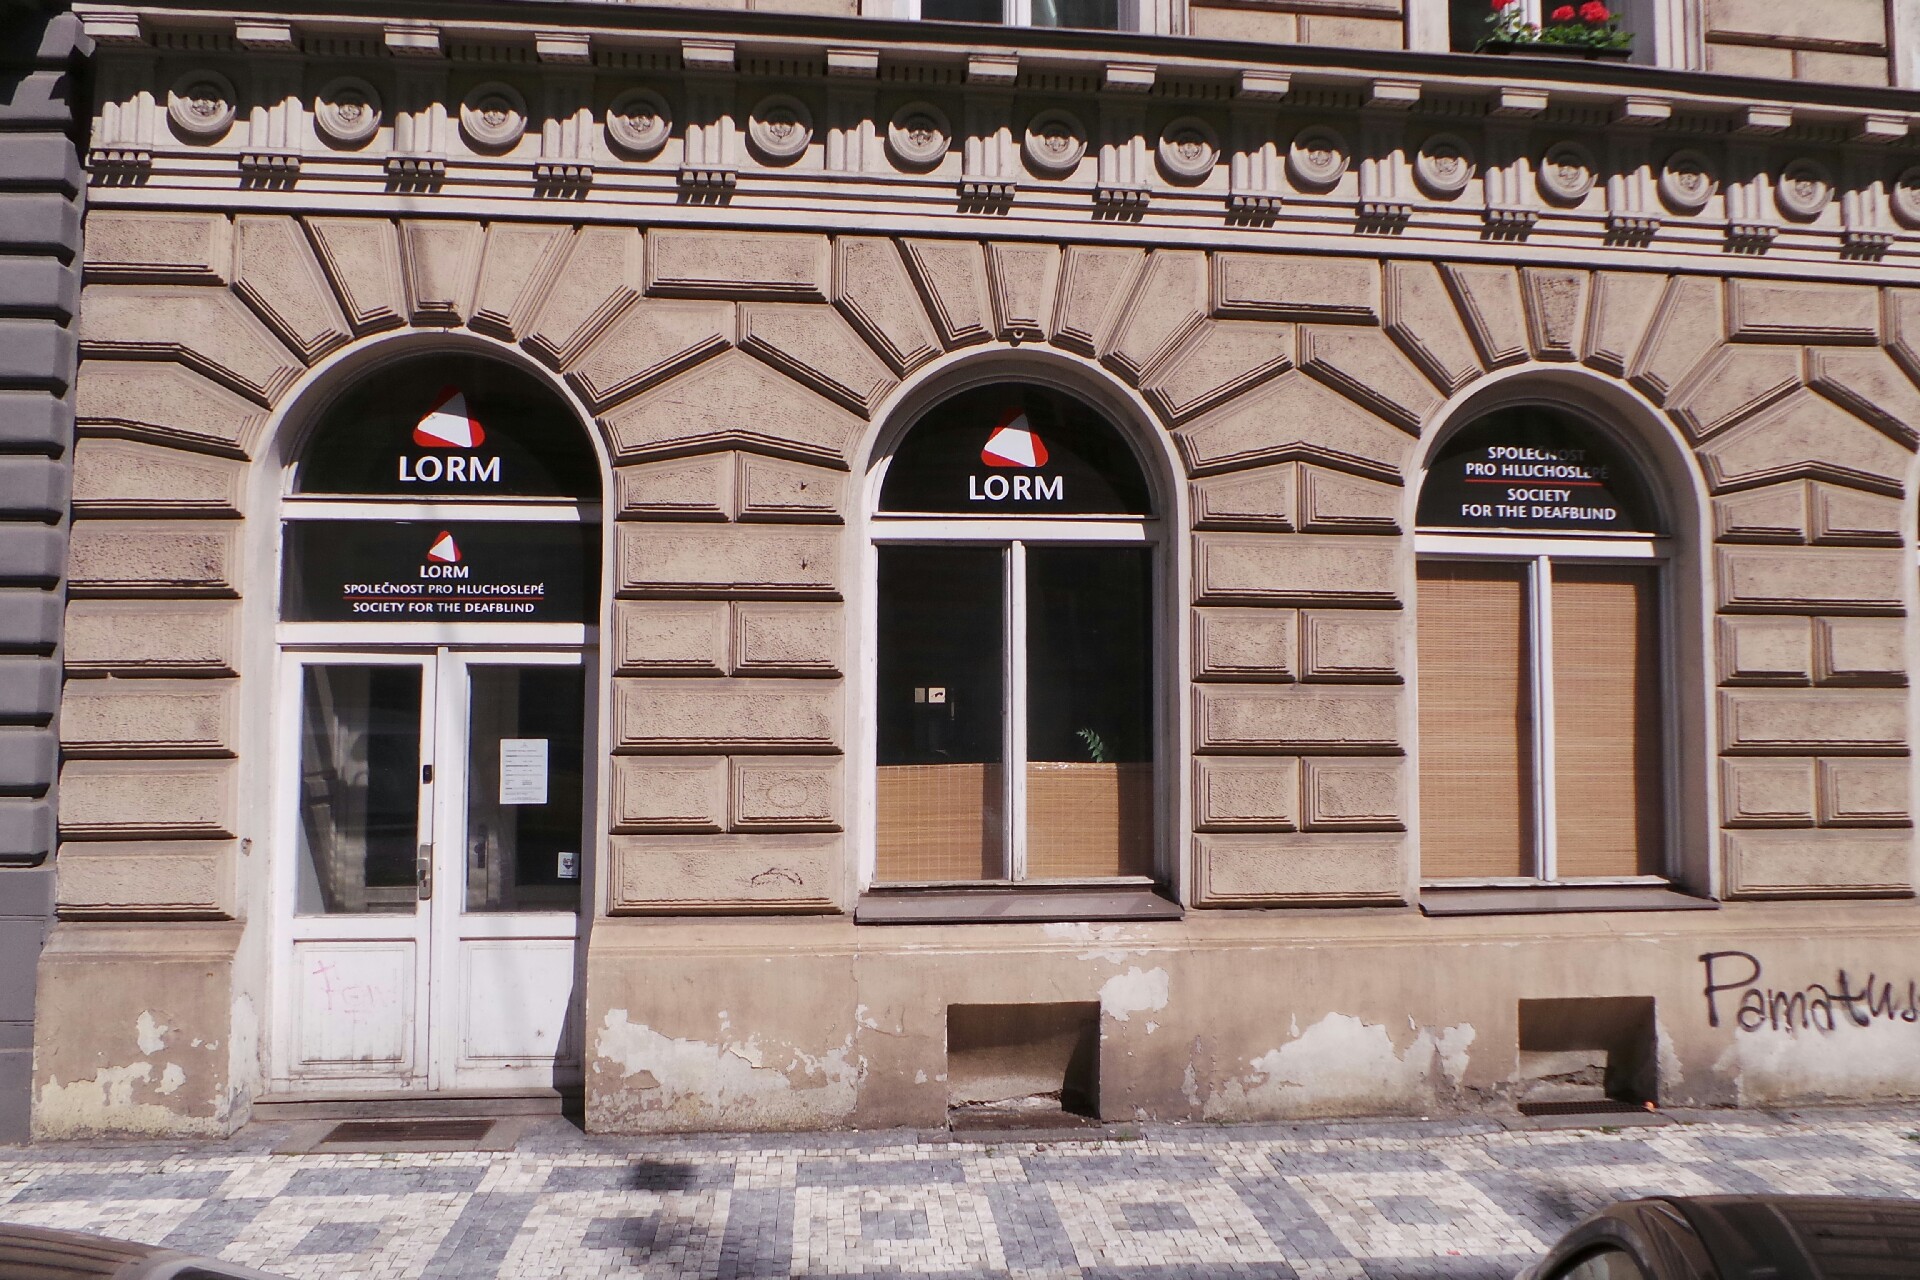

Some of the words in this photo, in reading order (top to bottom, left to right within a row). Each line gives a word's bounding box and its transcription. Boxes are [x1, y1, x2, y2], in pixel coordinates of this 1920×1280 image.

[399, 456, 501, 482] LORM
[1465, 462, 1497, 477] PRO
[1501, 463, 1609, 480] HLUCHOSLEPÉ
[969, 475, 1064, 501] LORM
[1507, 488, 1571, 503] SOCIETY
[1461, 504, 1493, 517] FOR
[1495, 505, 1528, 518] THE
[1531, 506, 1617, 521] DEAFBLIND
[420, 565, 469, 579] LORM
[343, 581, 425, 595] SPOLEČNOST
[428, 584, 453, 595] PRO
[456, 582, 545, 595] HLUCHOSLEPÉ
[352, 602, 405, 613] SOCIETY
[408, 602, 434, 613] FOR
[437, 602, 461, 613] THE
[464, 602, 535, 613] DEAFBLIND
